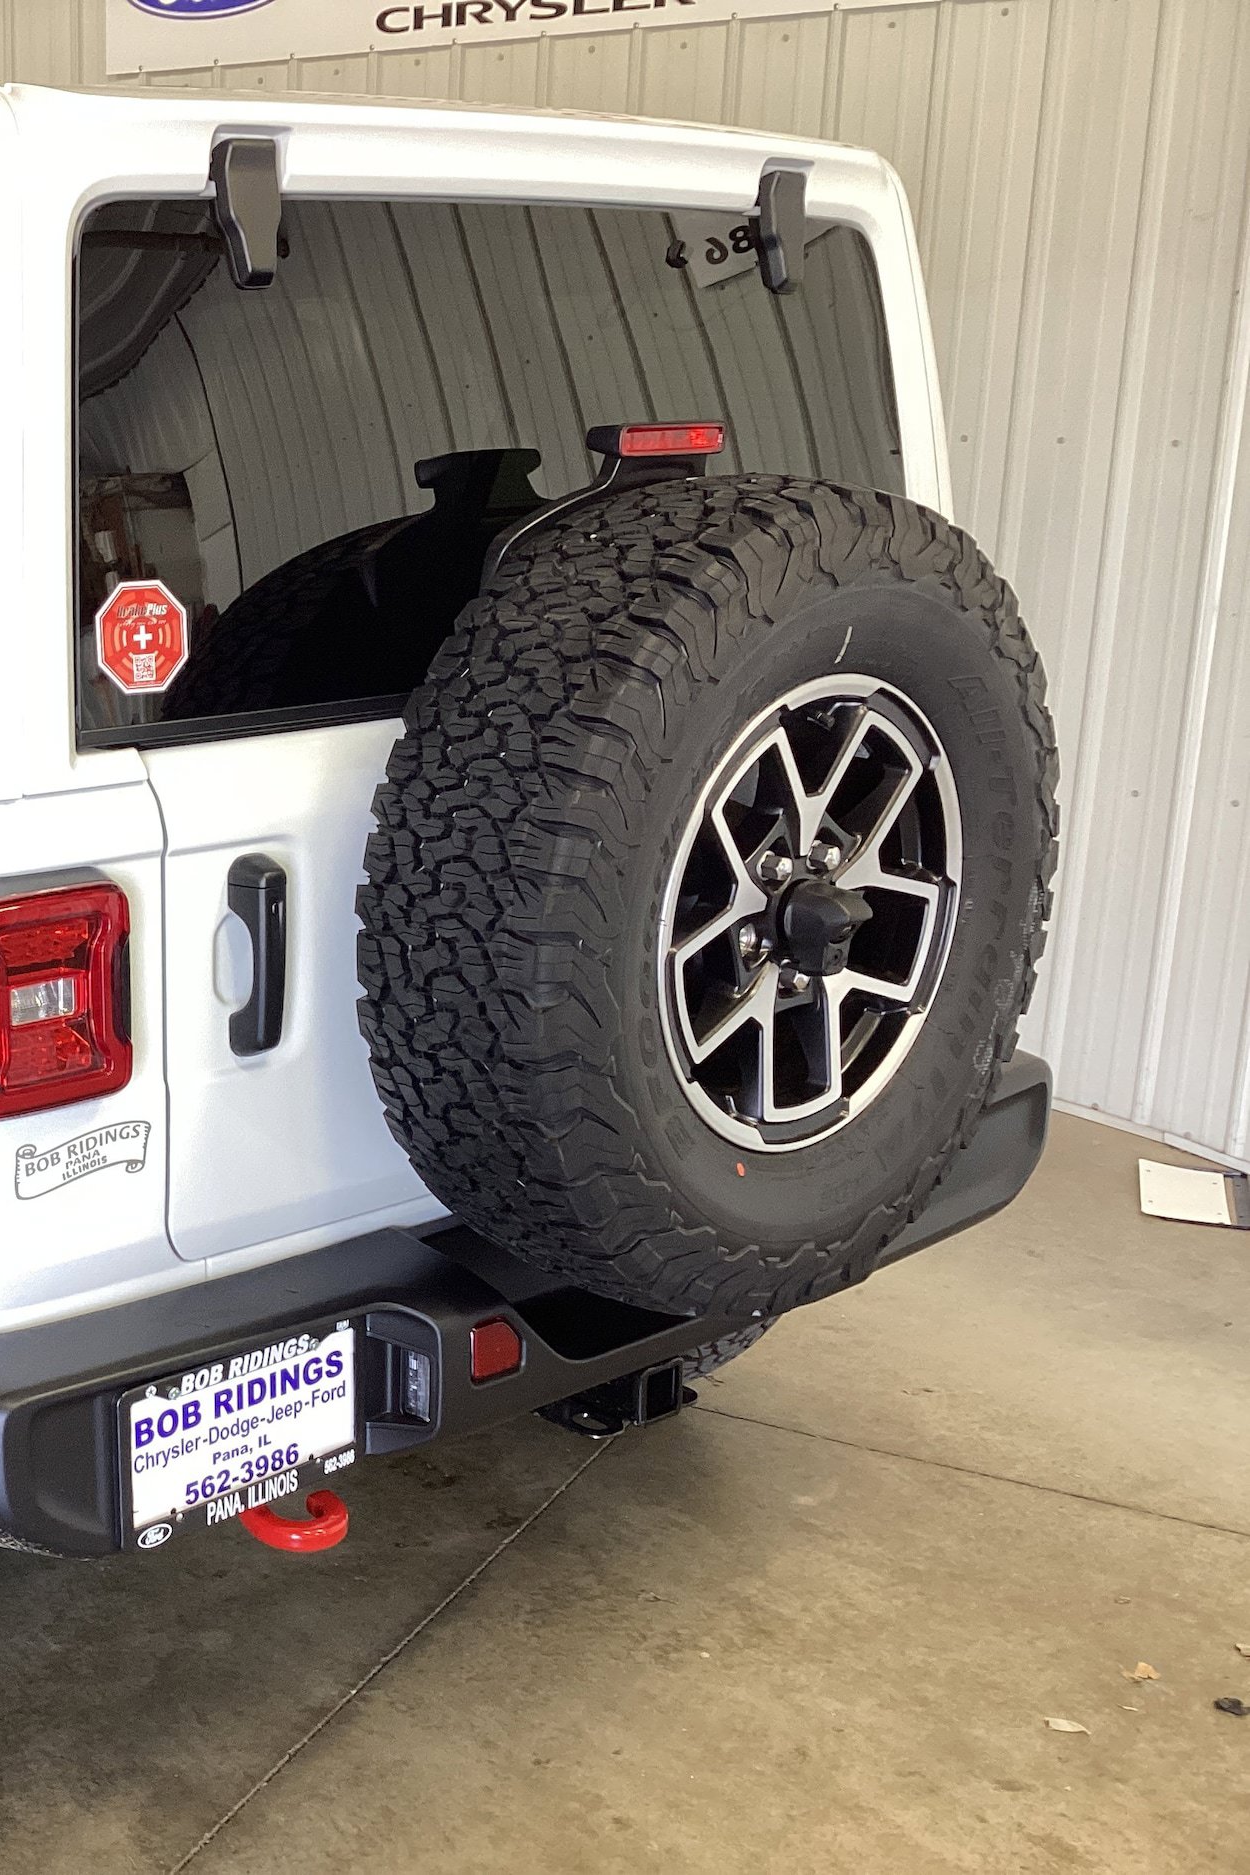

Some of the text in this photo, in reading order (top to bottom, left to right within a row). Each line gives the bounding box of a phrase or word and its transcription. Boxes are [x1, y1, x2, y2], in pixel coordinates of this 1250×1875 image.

[375, 0, 695, 33] CHRYSL
[24, 1124, 141, 1177] BOB RIDINGS
[62, 1155, 108, 1181] ILLINOIS
[65, 1149, 100, 1170] PANA
[181, 1333, 310, 1396] BOB RIDINGS
[134, 1350, 344, 1449] BOB RIDINGS
[134, 1380, 346, 1474] Chrysler-Dodge-Jeep-Ford
[212, 1434, 272, 1465] Pana, IL
[185, 1442, 300, 1505] 562-3986
[247, 1469, 298, 1510] ILLINOIS
